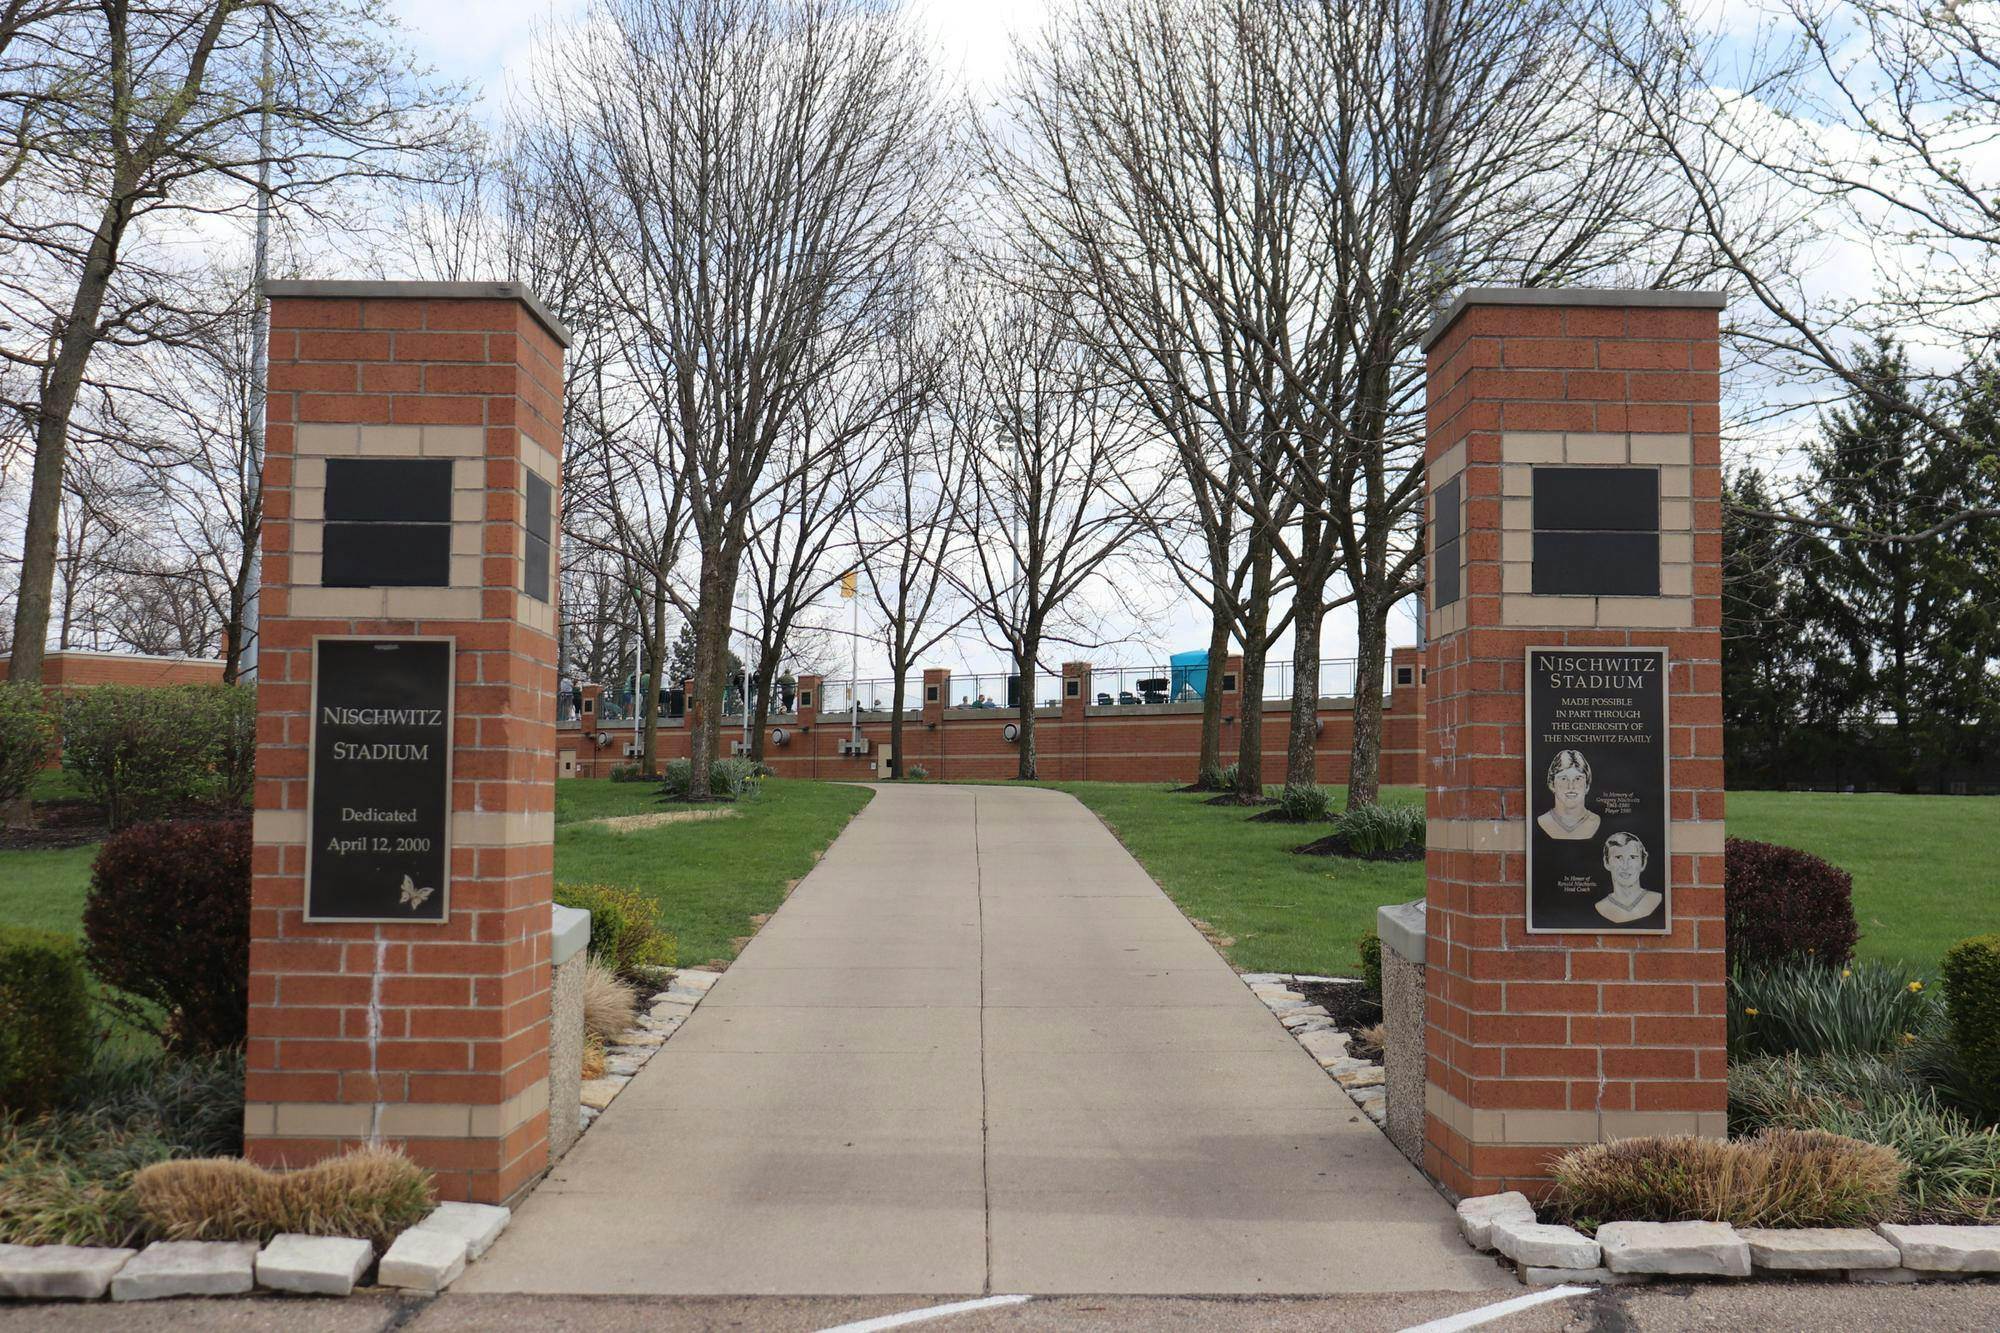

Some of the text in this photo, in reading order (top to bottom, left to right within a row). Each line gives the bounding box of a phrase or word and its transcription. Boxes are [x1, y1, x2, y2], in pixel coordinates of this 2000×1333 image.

[1540, 656, 1655, 672] NISCHWITZ
[1550, 673, 1643, 689] STADIUM
[1561, 698, 1633, 706] MADE POSSIBLE
[323, 706, 442, 726] NISCHWITZ
[1556, 710, 1640, 718] IN PART THROUGH
[1552, 722, 1644, 731] THE GENEROSITY OF
[1543, 734, 1652, 743] THE NISCHWITZ FAMILY
[333, 741, 429, 760] STADIUM
[342, 807, 418, 822] Dedicated
[327, 836, 430, 855] April 12, 2000
